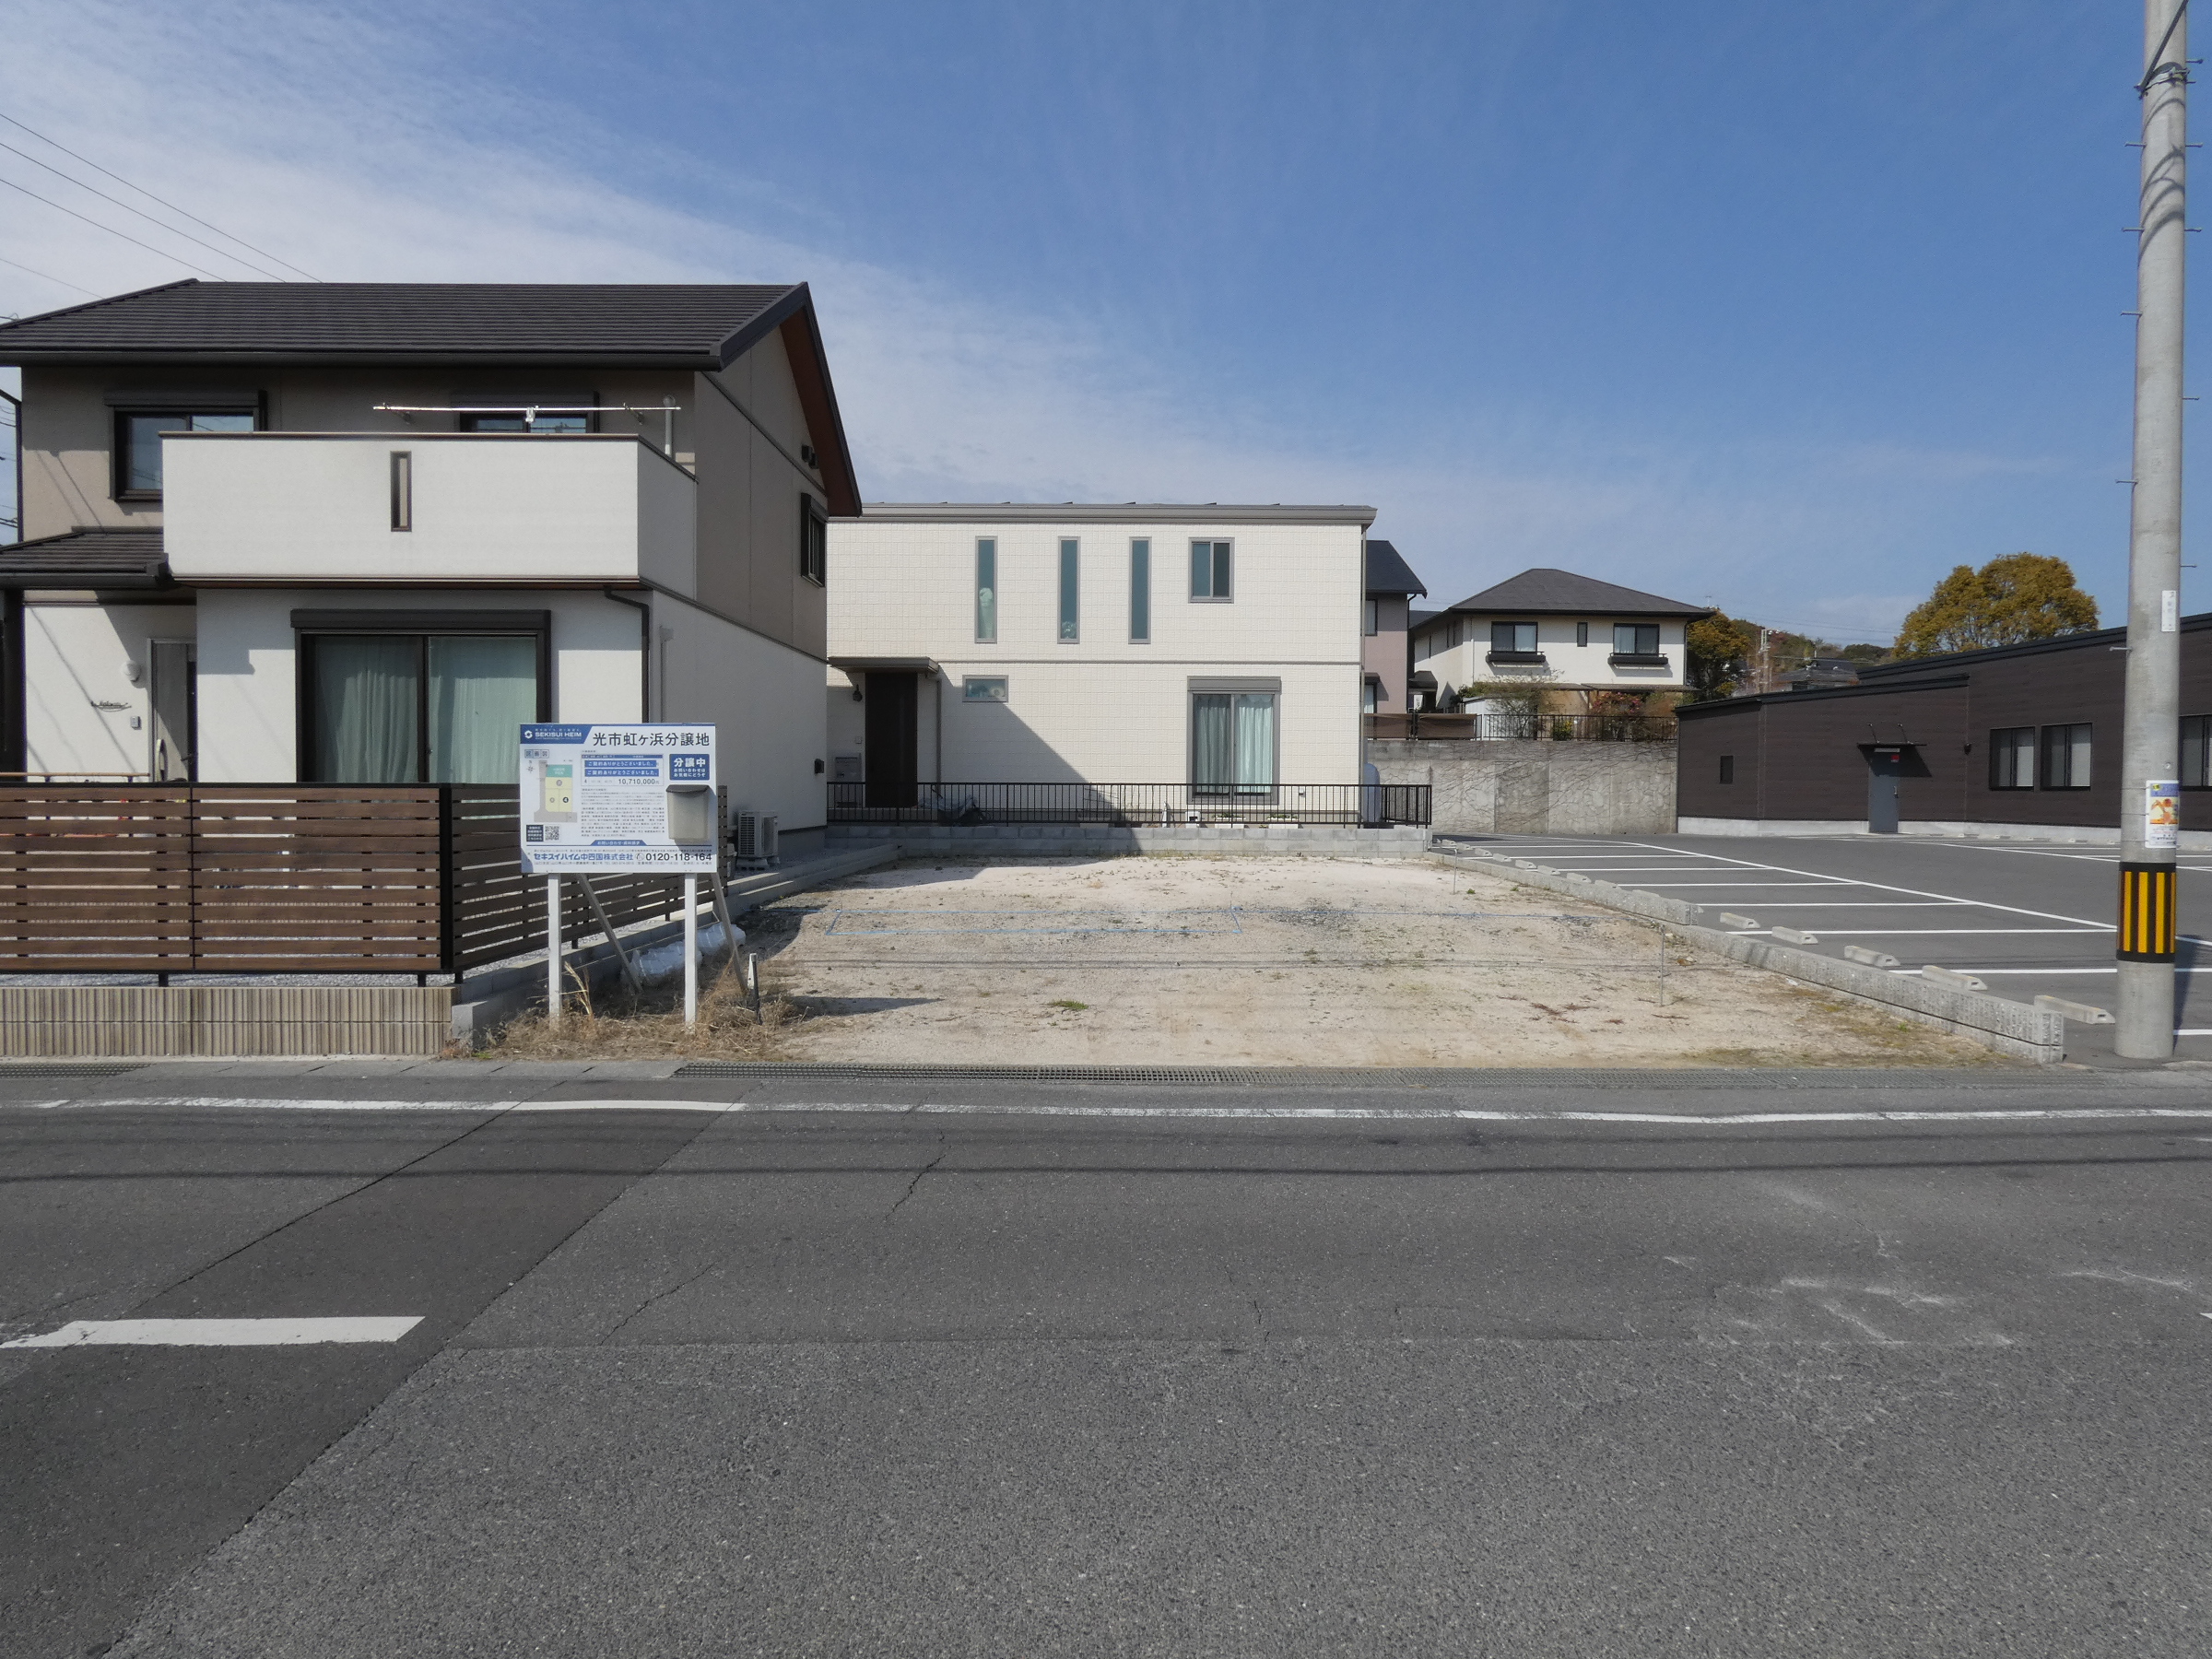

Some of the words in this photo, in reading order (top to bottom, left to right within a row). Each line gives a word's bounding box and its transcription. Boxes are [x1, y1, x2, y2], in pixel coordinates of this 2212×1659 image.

[673, 757, 706, 768] 分譲中
[645, 853, 712, 861] 0120-118-164
